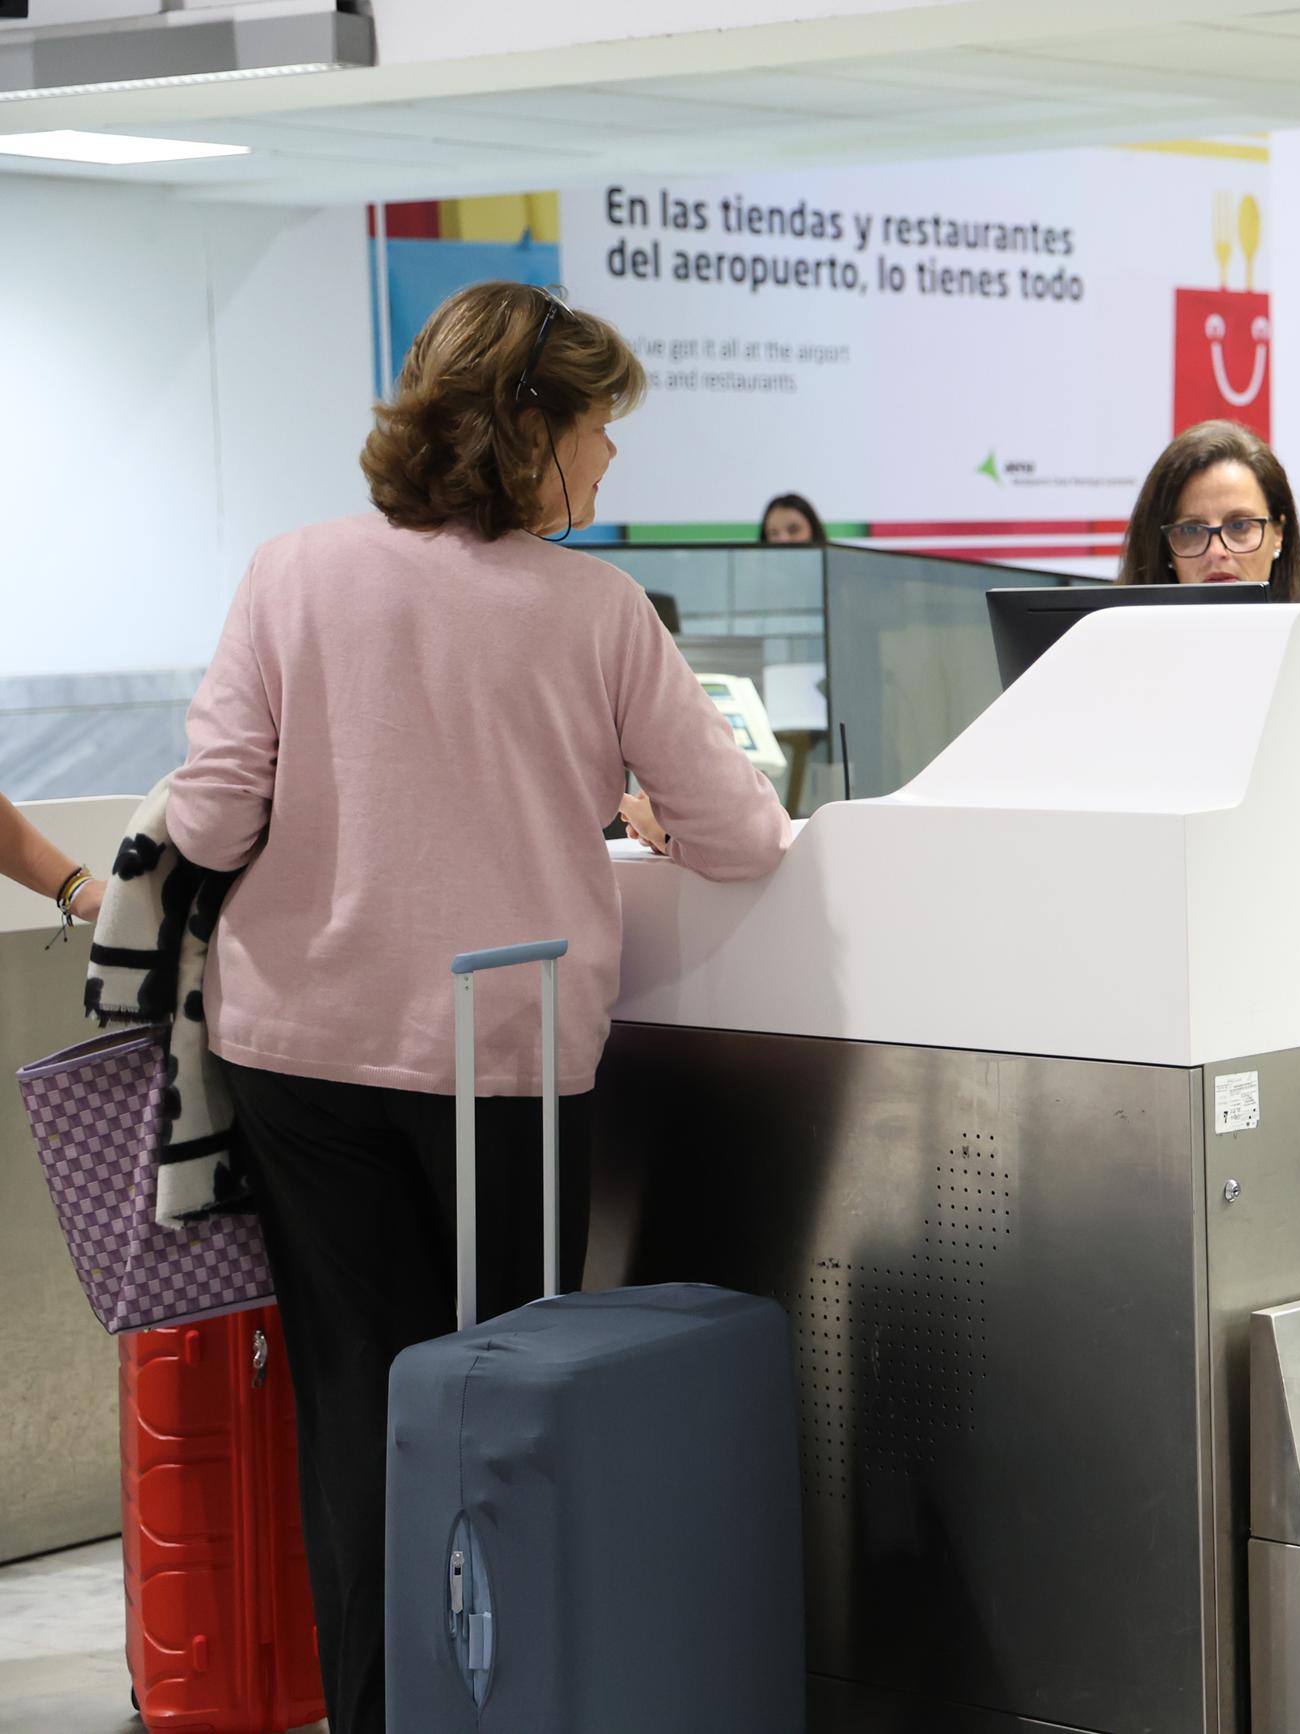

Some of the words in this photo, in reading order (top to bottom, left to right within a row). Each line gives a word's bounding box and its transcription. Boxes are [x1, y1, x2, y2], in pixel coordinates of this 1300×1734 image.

[606, 187, 647, 227] En
[660, 189, 708, 231] las
[721, 194, 843, 240] tiendas
[853, 212, 872, 251] y
[883, 212, 1074, 255] restaurantes
[607, 237, 660, 278] del
[673, 251, 867, 296] aeropuerto,
[878, 255, 905, 292] lo
[917, 258, 1009, 298] tienes
[1020, 268, 1083, 302] todo
[669, 338, 698, 362] got
[720, 338, 738, 359] all
[745, 340, 760, 360] at
[767, 340, 793, 361] the
[798, 343, 851, 365] airport
[666, 369, 697, 391] and
